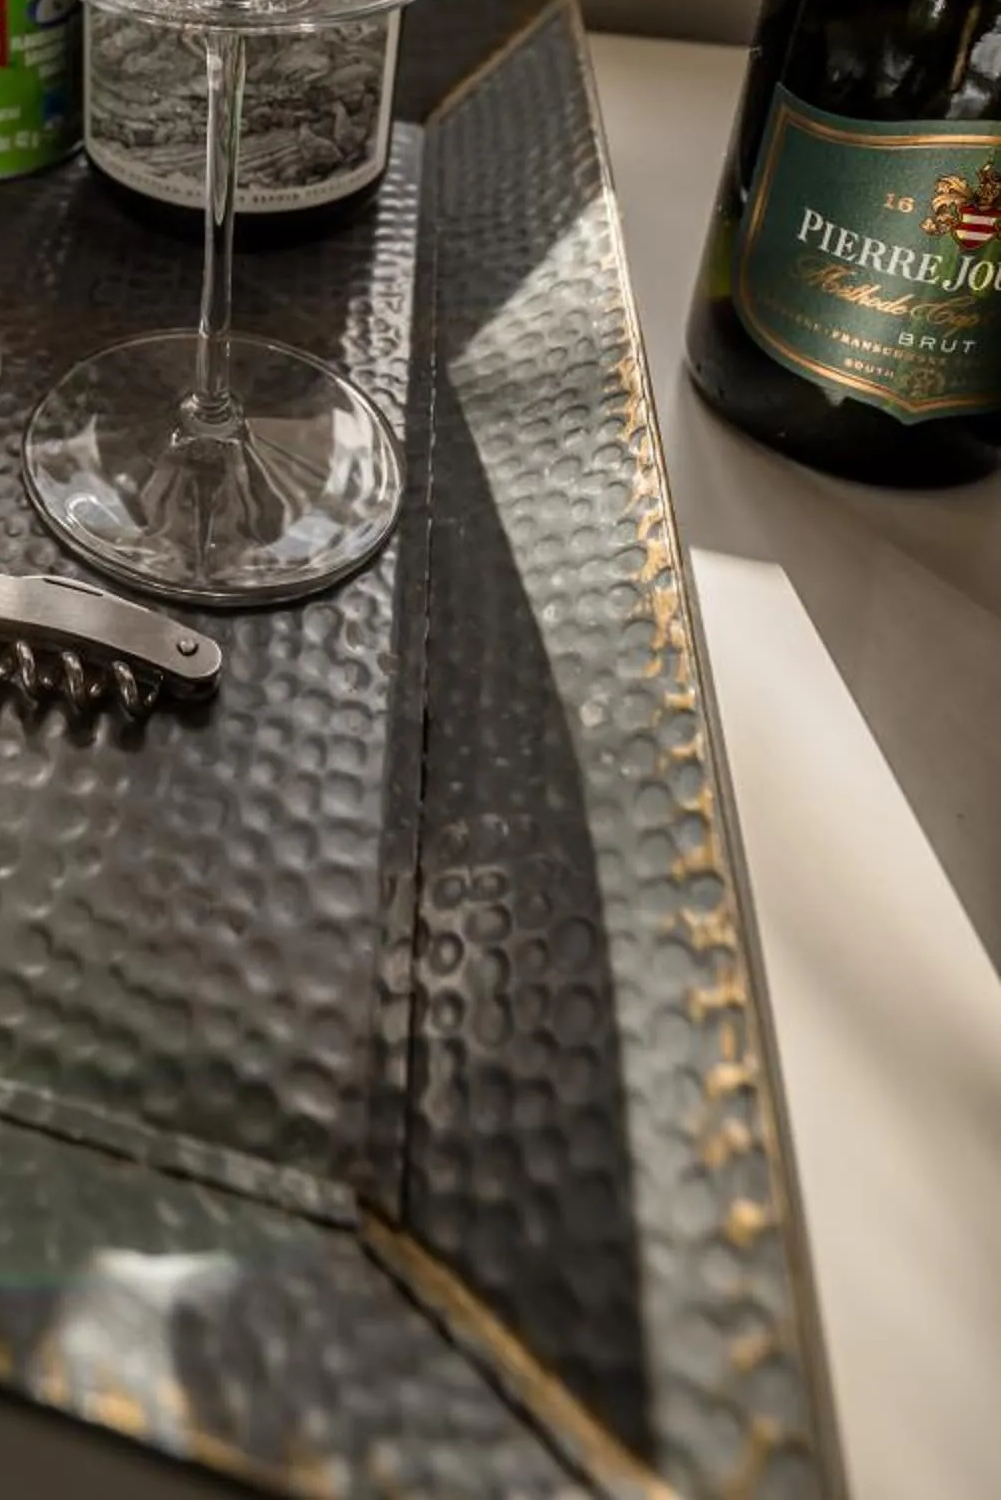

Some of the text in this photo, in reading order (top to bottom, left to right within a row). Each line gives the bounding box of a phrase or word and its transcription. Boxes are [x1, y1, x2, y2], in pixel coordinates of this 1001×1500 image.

[884, 193, 916, 213] 16
[798, 208, 1001, 292] PIERRE JO
[898, 331, 975, 353] BRUT
